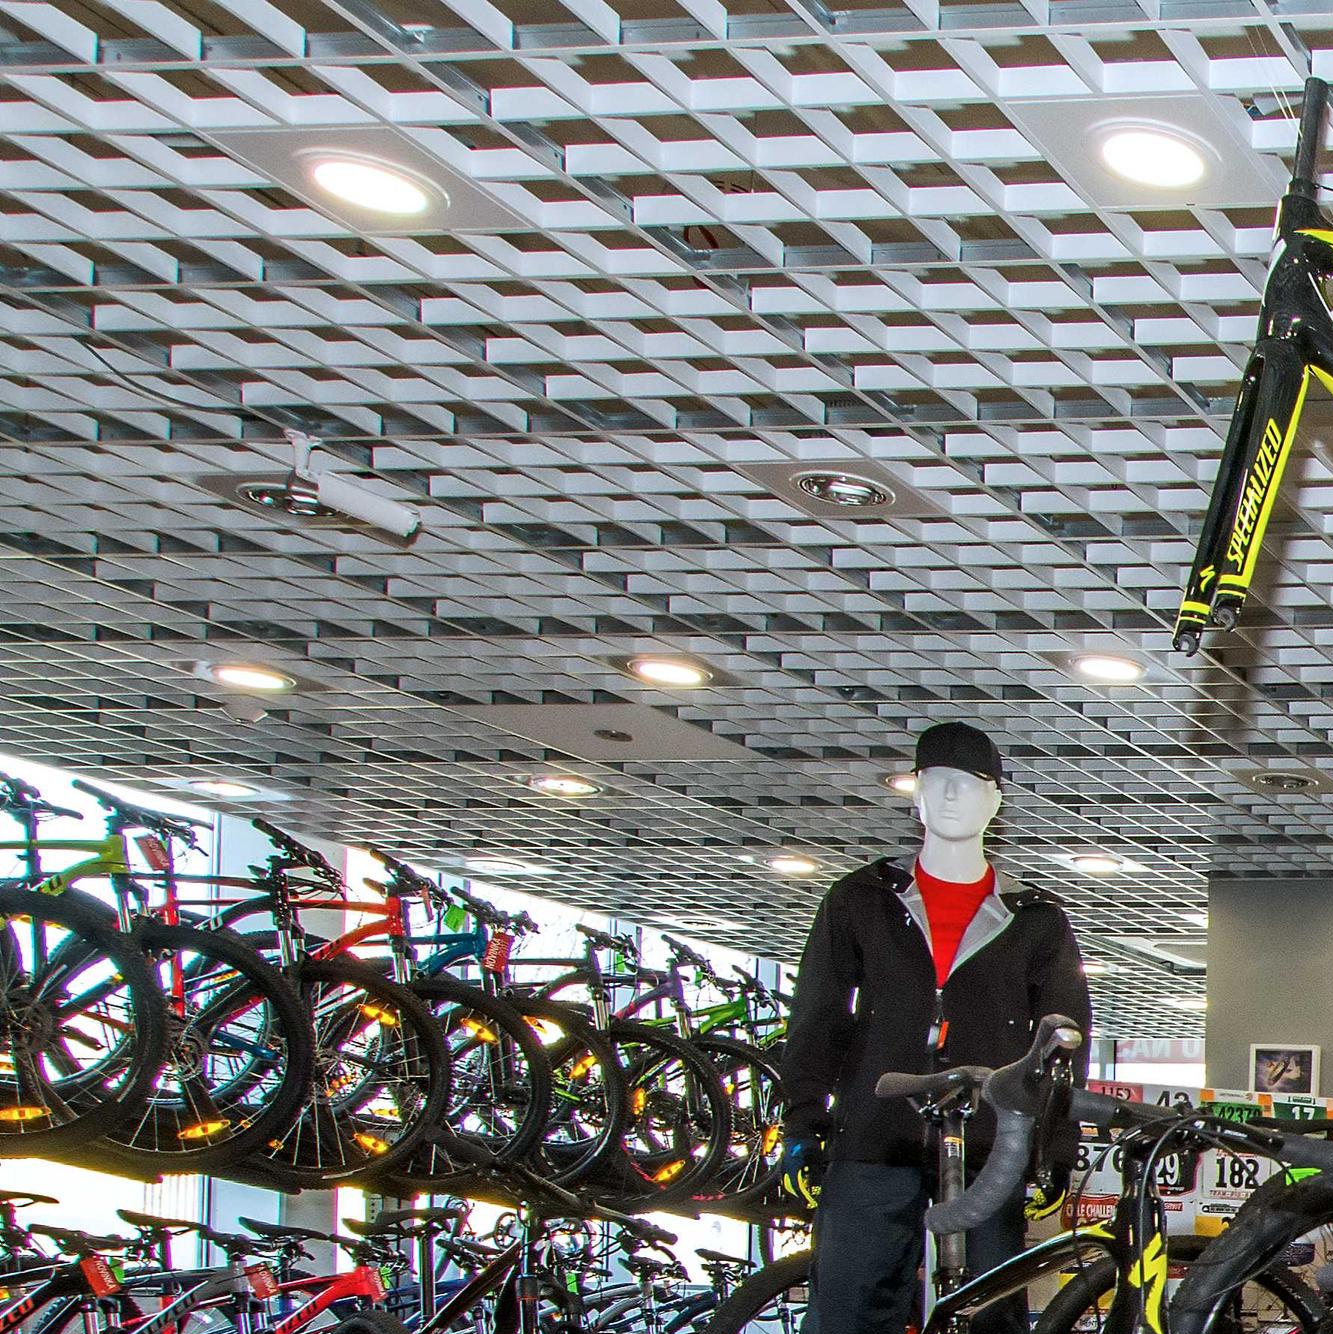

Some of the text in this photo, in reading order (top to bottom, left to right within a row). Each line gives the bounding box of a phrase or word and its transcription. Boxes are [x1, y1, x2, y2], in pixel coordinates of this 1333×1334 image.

[1225, 417, 1284, 573] SPECIALIZED
[1290, 1106, 1316, 1121] 17
[1215, 1156, 1260, 1189] 182
